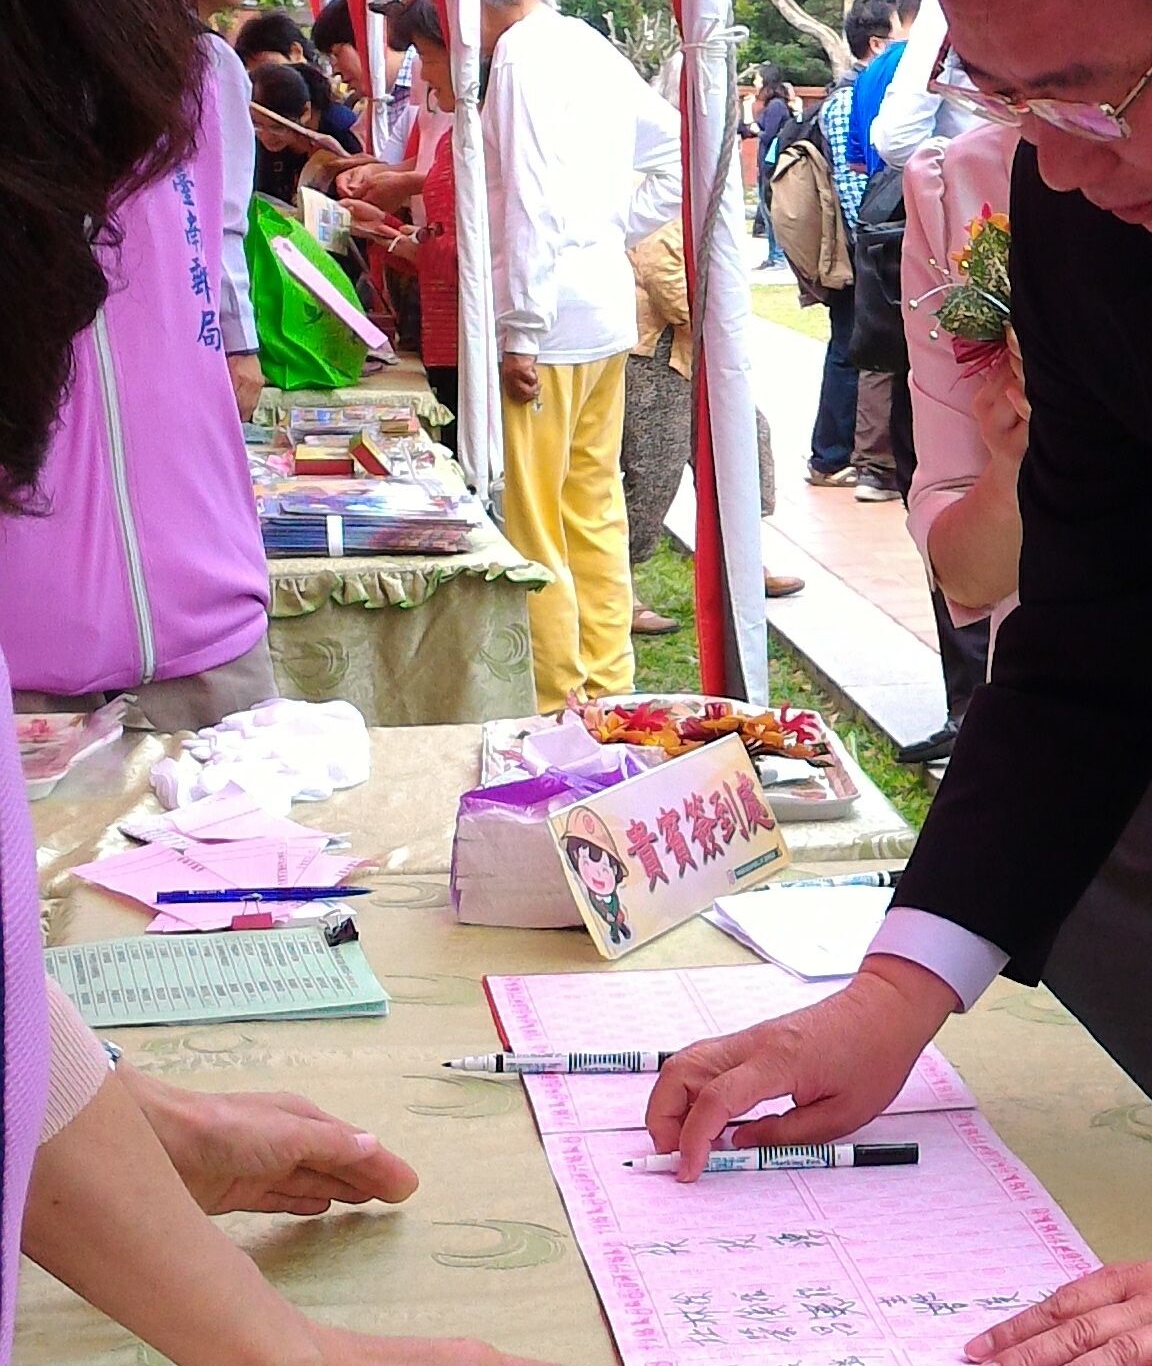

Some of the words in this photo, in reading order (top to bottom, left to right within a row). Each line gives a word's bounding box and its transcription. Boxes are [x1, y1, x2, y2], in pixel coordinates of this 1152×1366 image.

[172, 164, 221, 351] 臺南郵局
[625, 770, 776, 893] 貴賓簽到處
